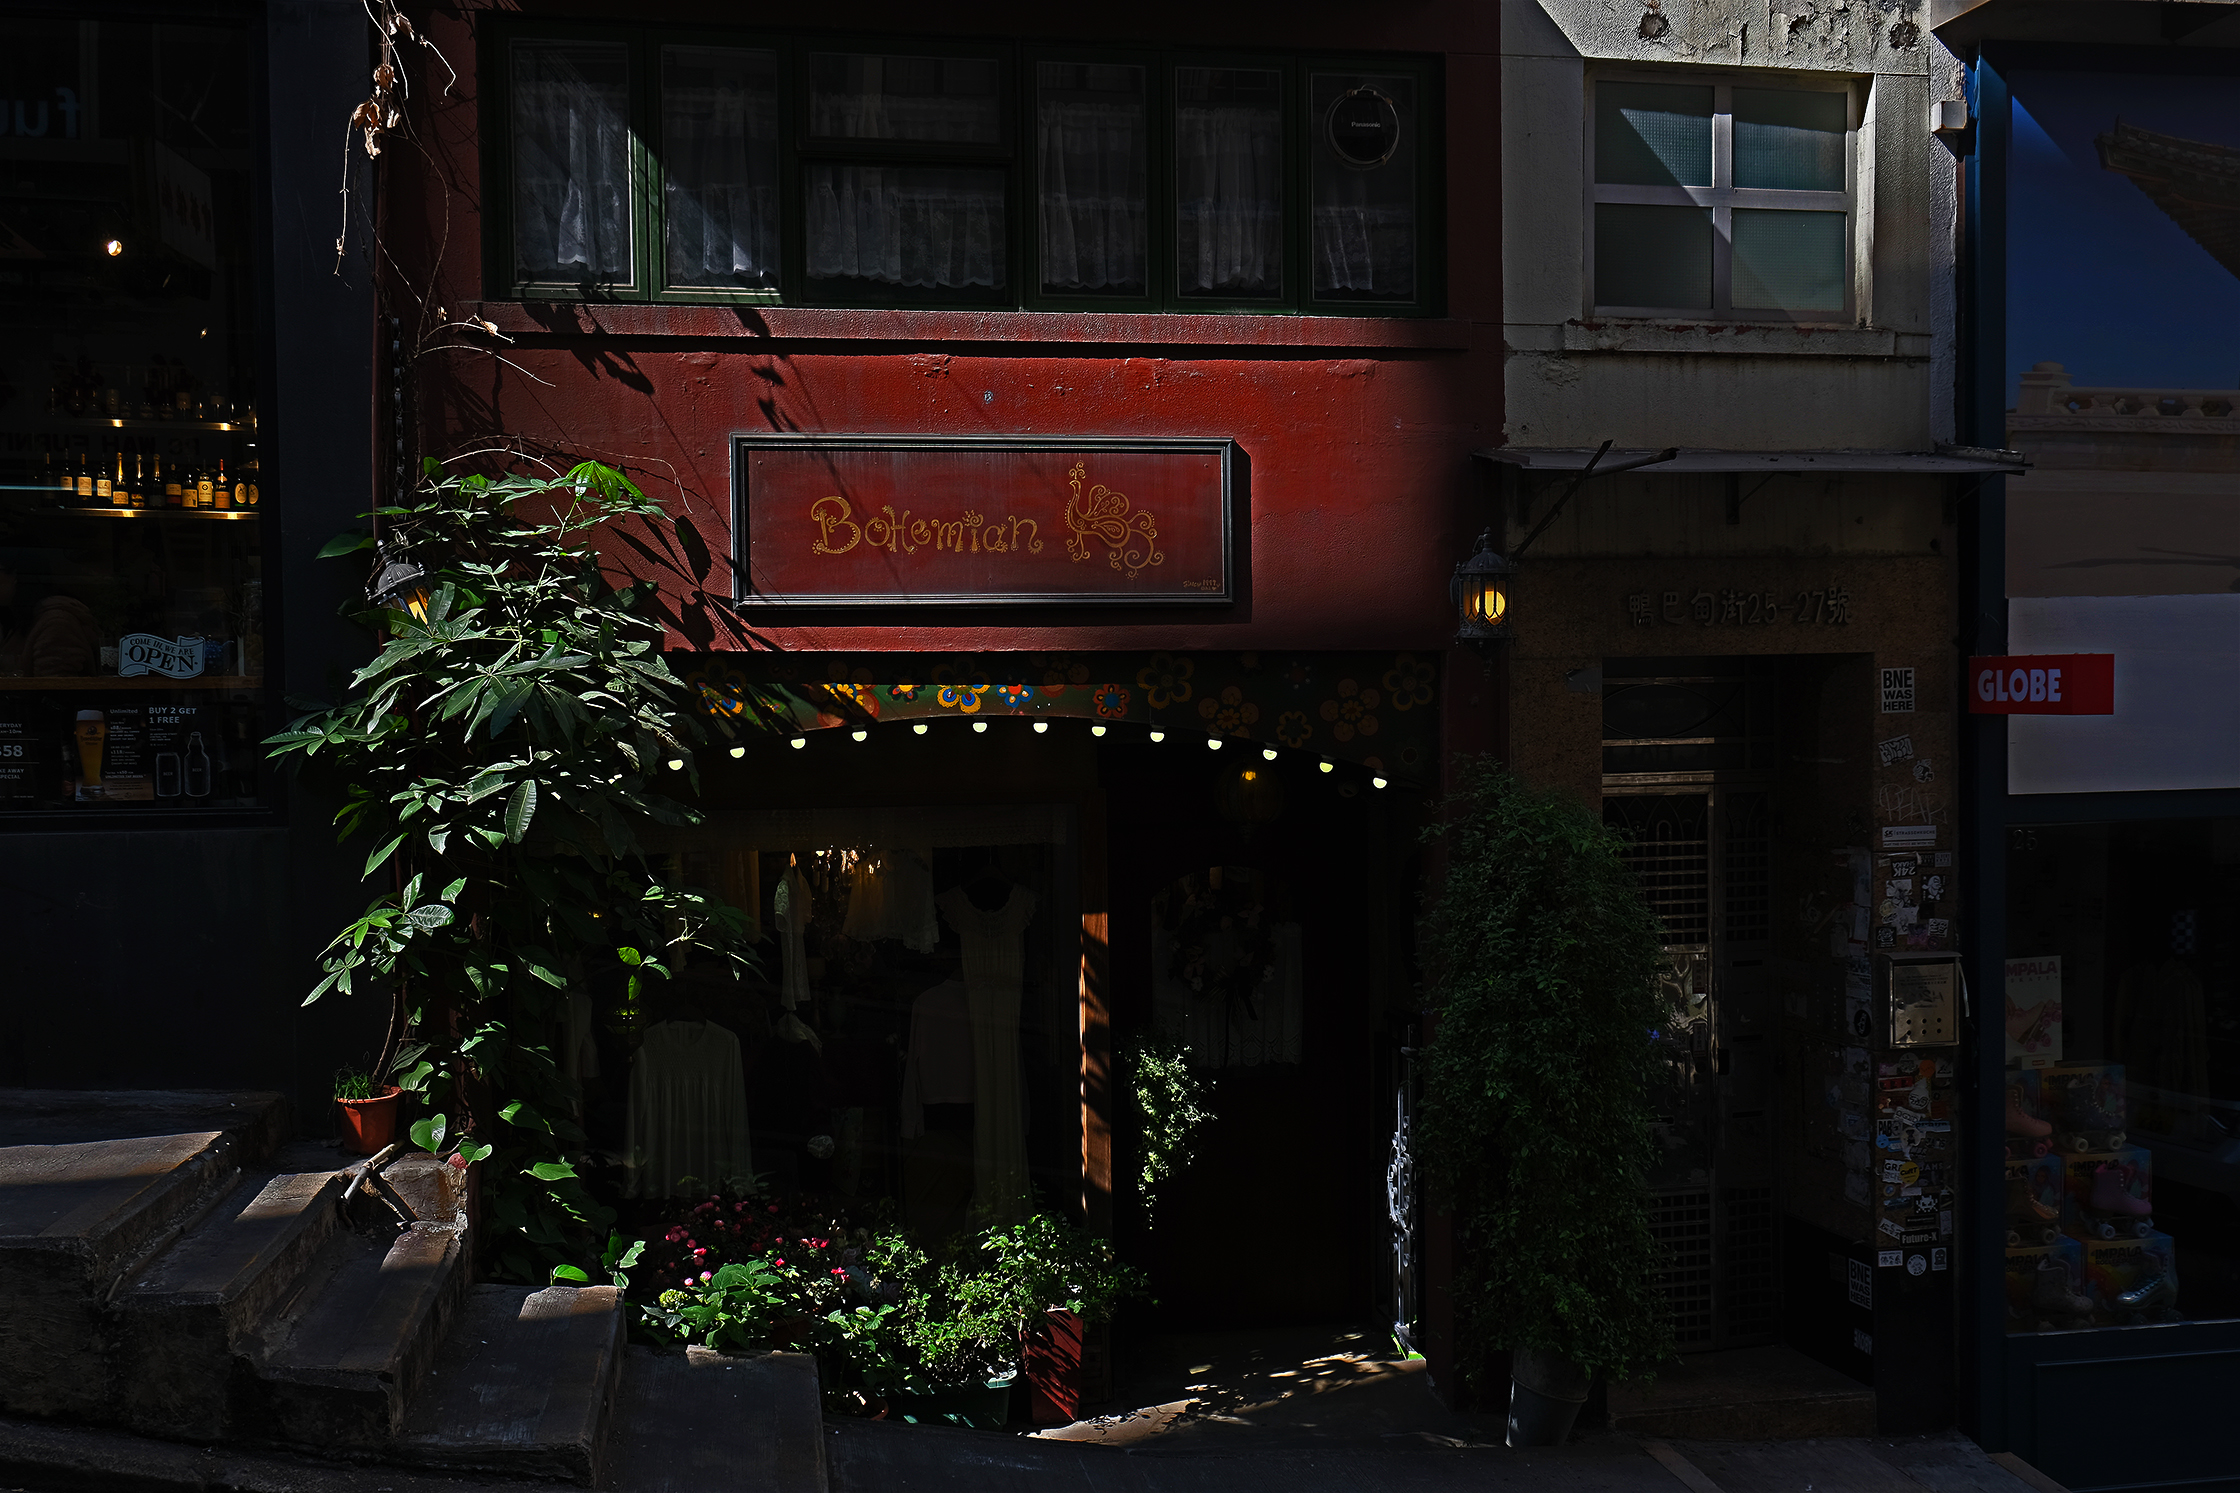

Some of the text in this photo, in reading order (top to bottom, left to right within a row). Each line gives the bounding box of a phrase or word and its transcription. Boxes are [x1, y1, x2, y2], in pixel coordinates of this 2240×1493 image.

[165, 645, 176, 653] WE
[129, 645, 195, 672] OPEN
[1883, 670, 1912, 688] BNE
[1977, 668, 2062, 702] GLOBE
[1883, 689, 1912, 700] WAS
[178, 707, 197, 715] GET
[1883, 700, 1913, 711] HERE
[2010, 829, 2038, 851] 25
[1902, 1232, 1938, 1244] Future-X
[2095, 1246, 2142, 1260] IMPALA
[1850, 1261, 1870, 1285] BNE
[1850, 1279, 1870, 1296] WAS
[1850, 1290, 1870, 1307] HERE
